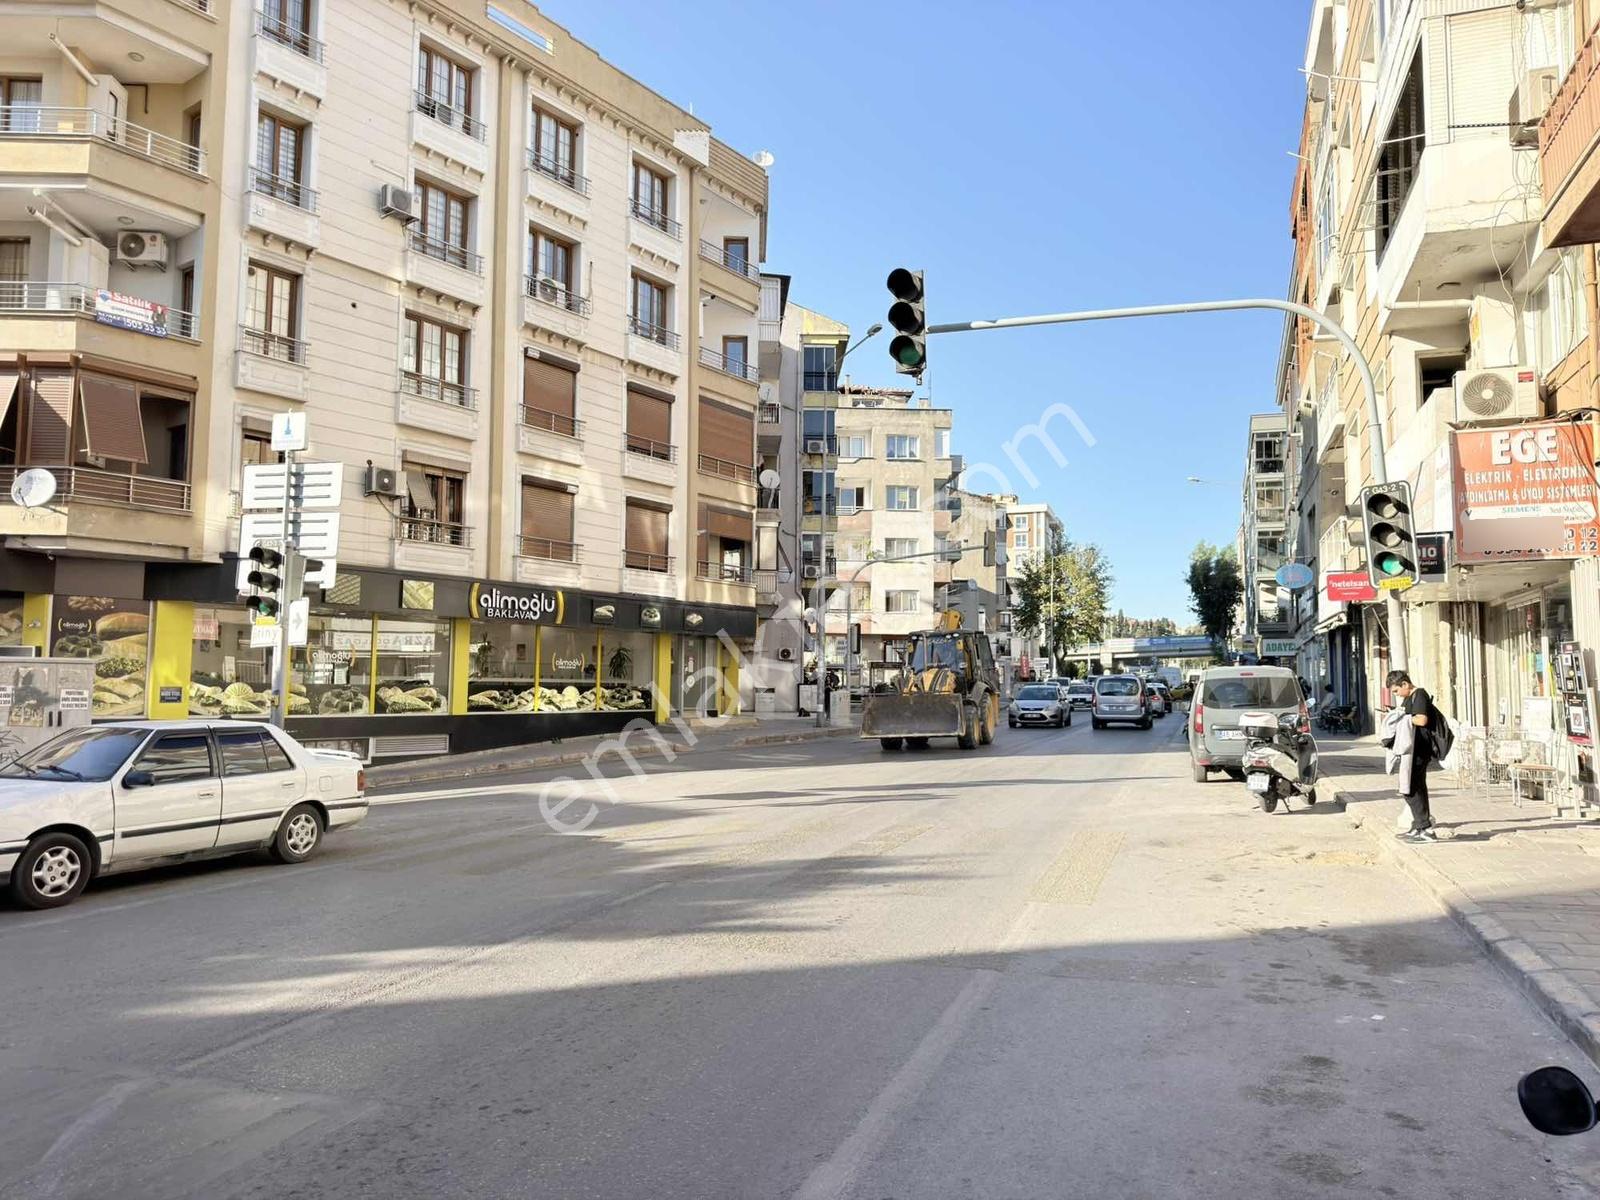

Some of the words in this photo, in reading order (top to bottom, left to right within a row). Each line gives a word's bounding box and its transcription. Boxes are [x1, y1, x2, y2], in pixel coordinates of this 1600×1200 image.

[1491, 427, 1558, 465] EGE
[480, 588, 555, 620] alimoğlu
[487, 608, 532, 620] BAKLAVA
